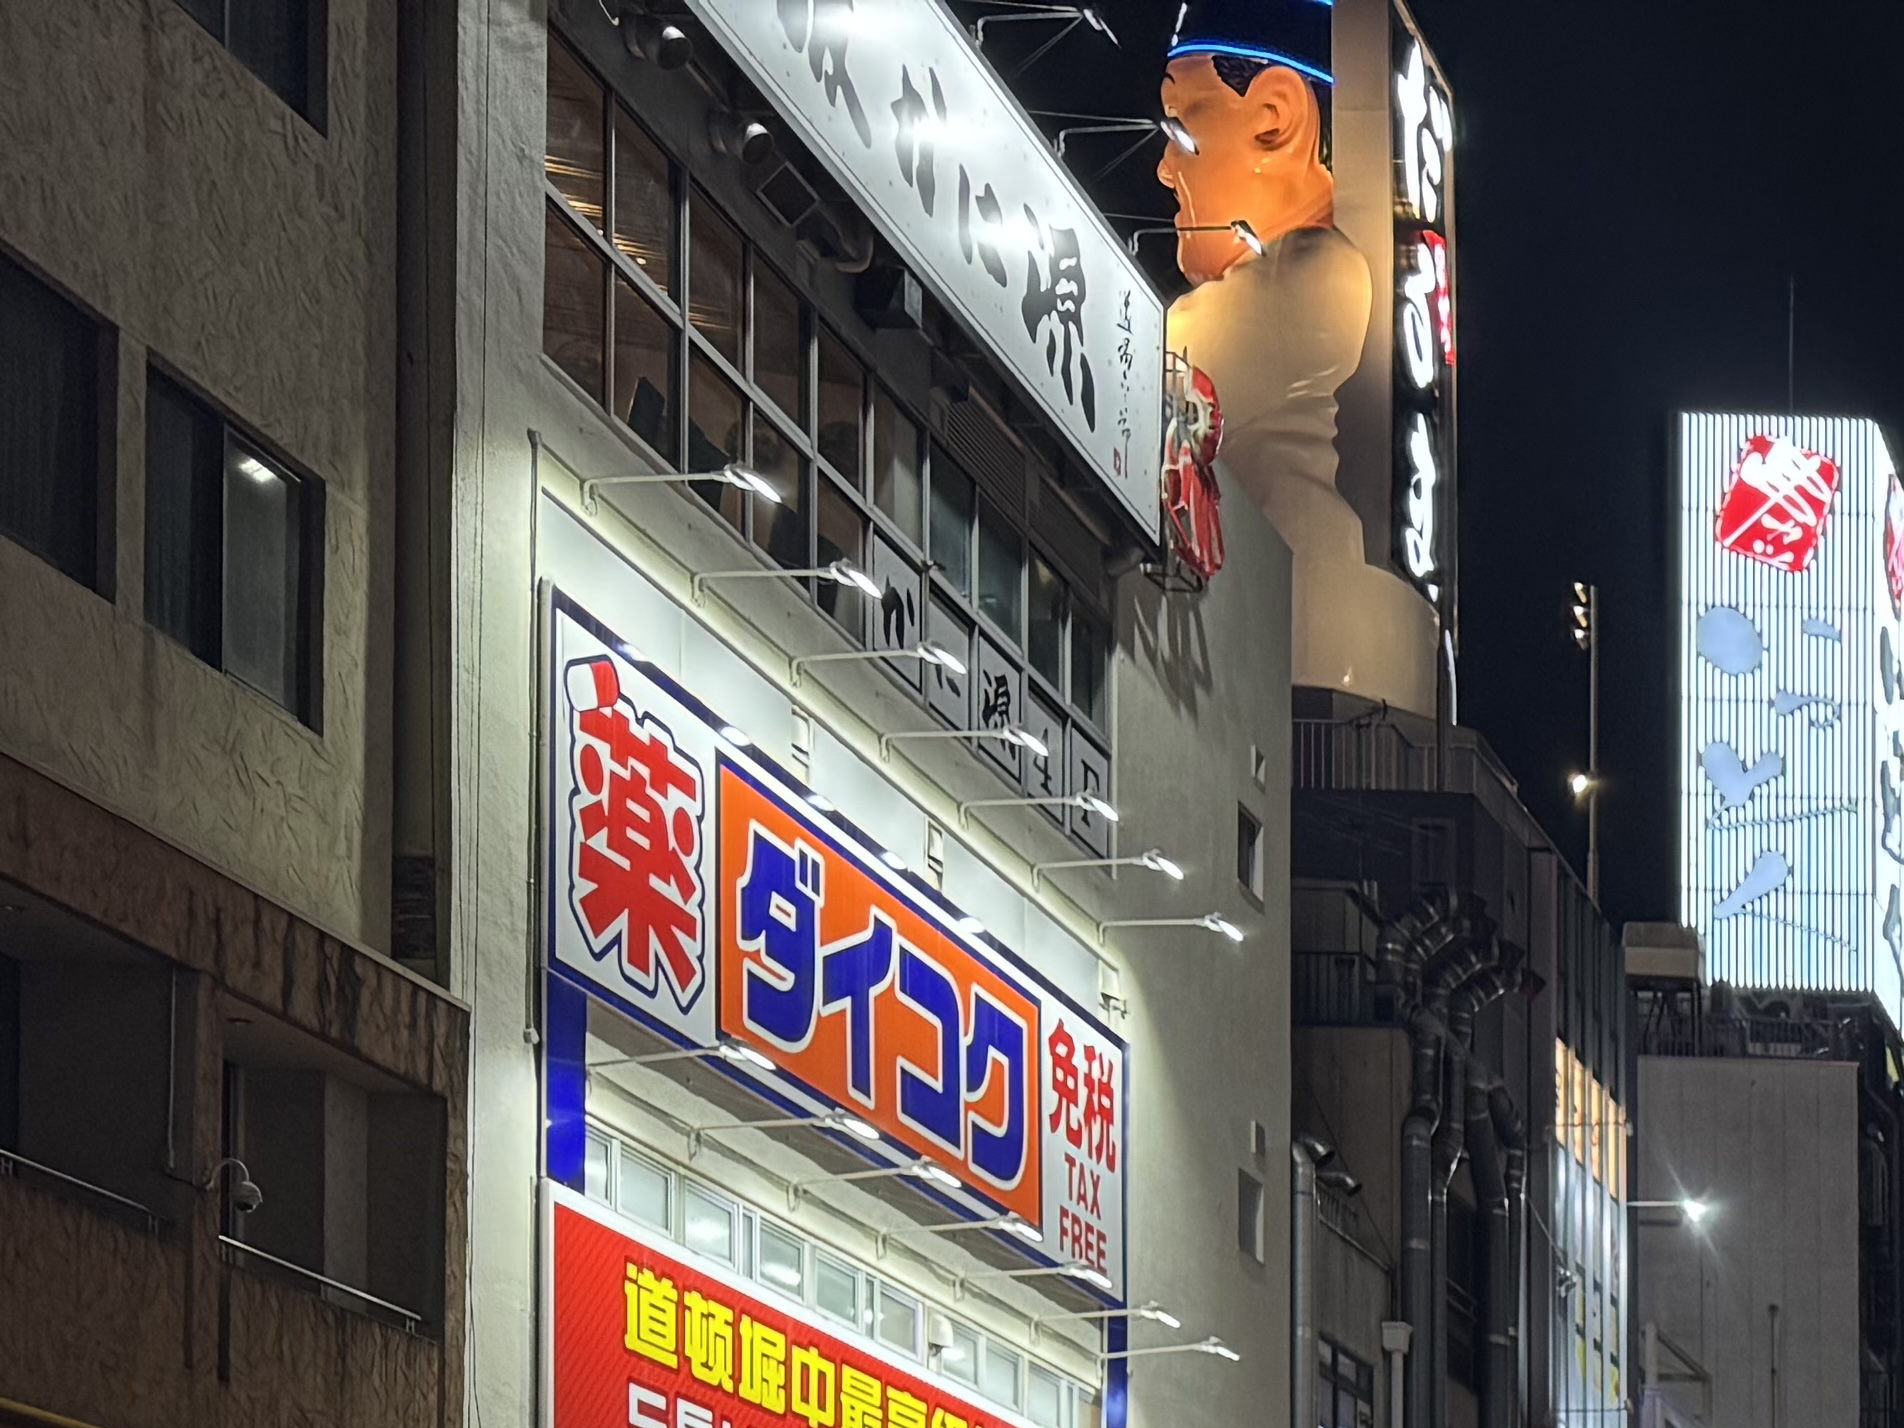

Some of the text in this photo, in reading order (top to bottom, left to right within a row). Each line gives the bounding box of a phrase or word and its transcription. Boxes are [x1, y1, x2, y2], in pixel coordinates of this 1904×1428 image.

[572, 655, 700, 1008] 薬
[741, 820, 1029, 1190] ダイコク
[1048, 1017, 1116, 1175] 免税
[1058, 1203, 1108, 1277] FREE
[1064, 1152, 1103, 1221] TAX
